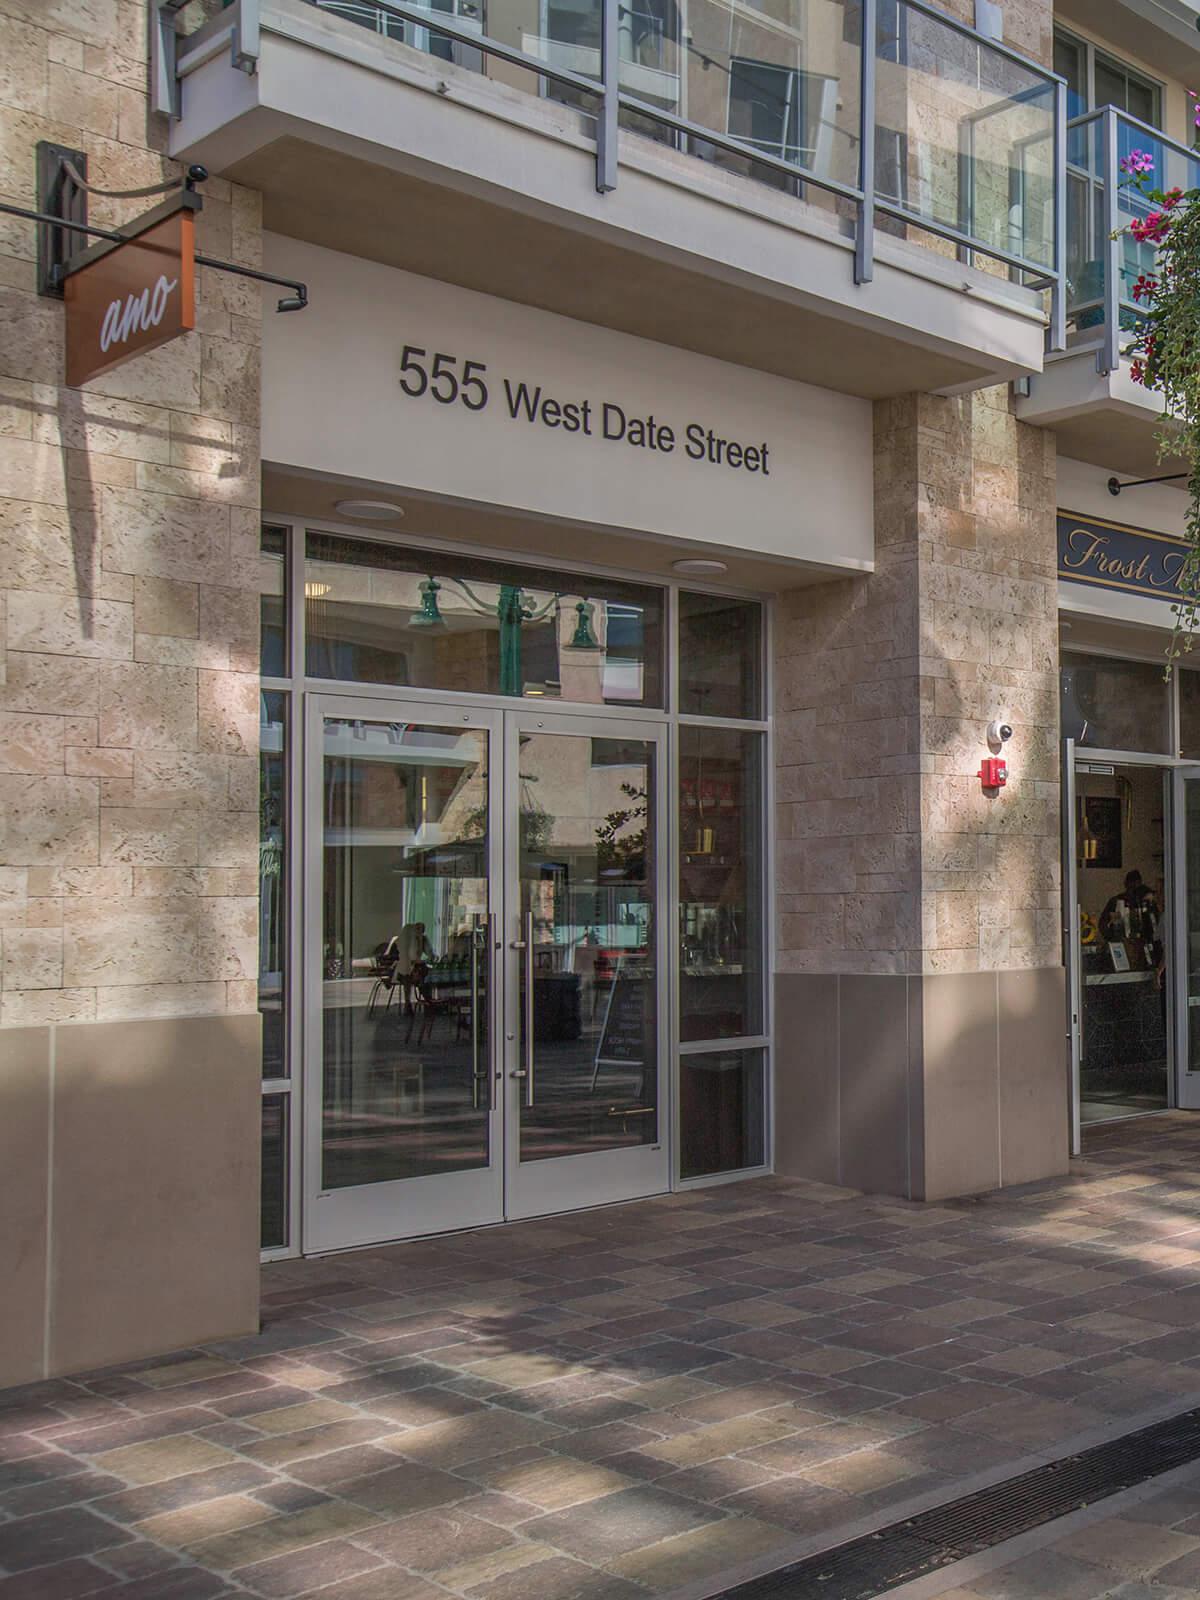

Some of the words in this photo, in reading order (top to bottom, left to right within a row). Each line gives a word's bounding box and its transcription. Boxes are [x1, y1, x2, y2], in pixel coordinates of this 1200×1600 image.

[100, 275, 177, 352] amo
[400, 344, 488, 411] 555
[503, 378, 592, 436] West
[602, 402, 675, 454] Date
[684, 423, 770, 475] Street
[1063, 529, 1150, 580] Frost
